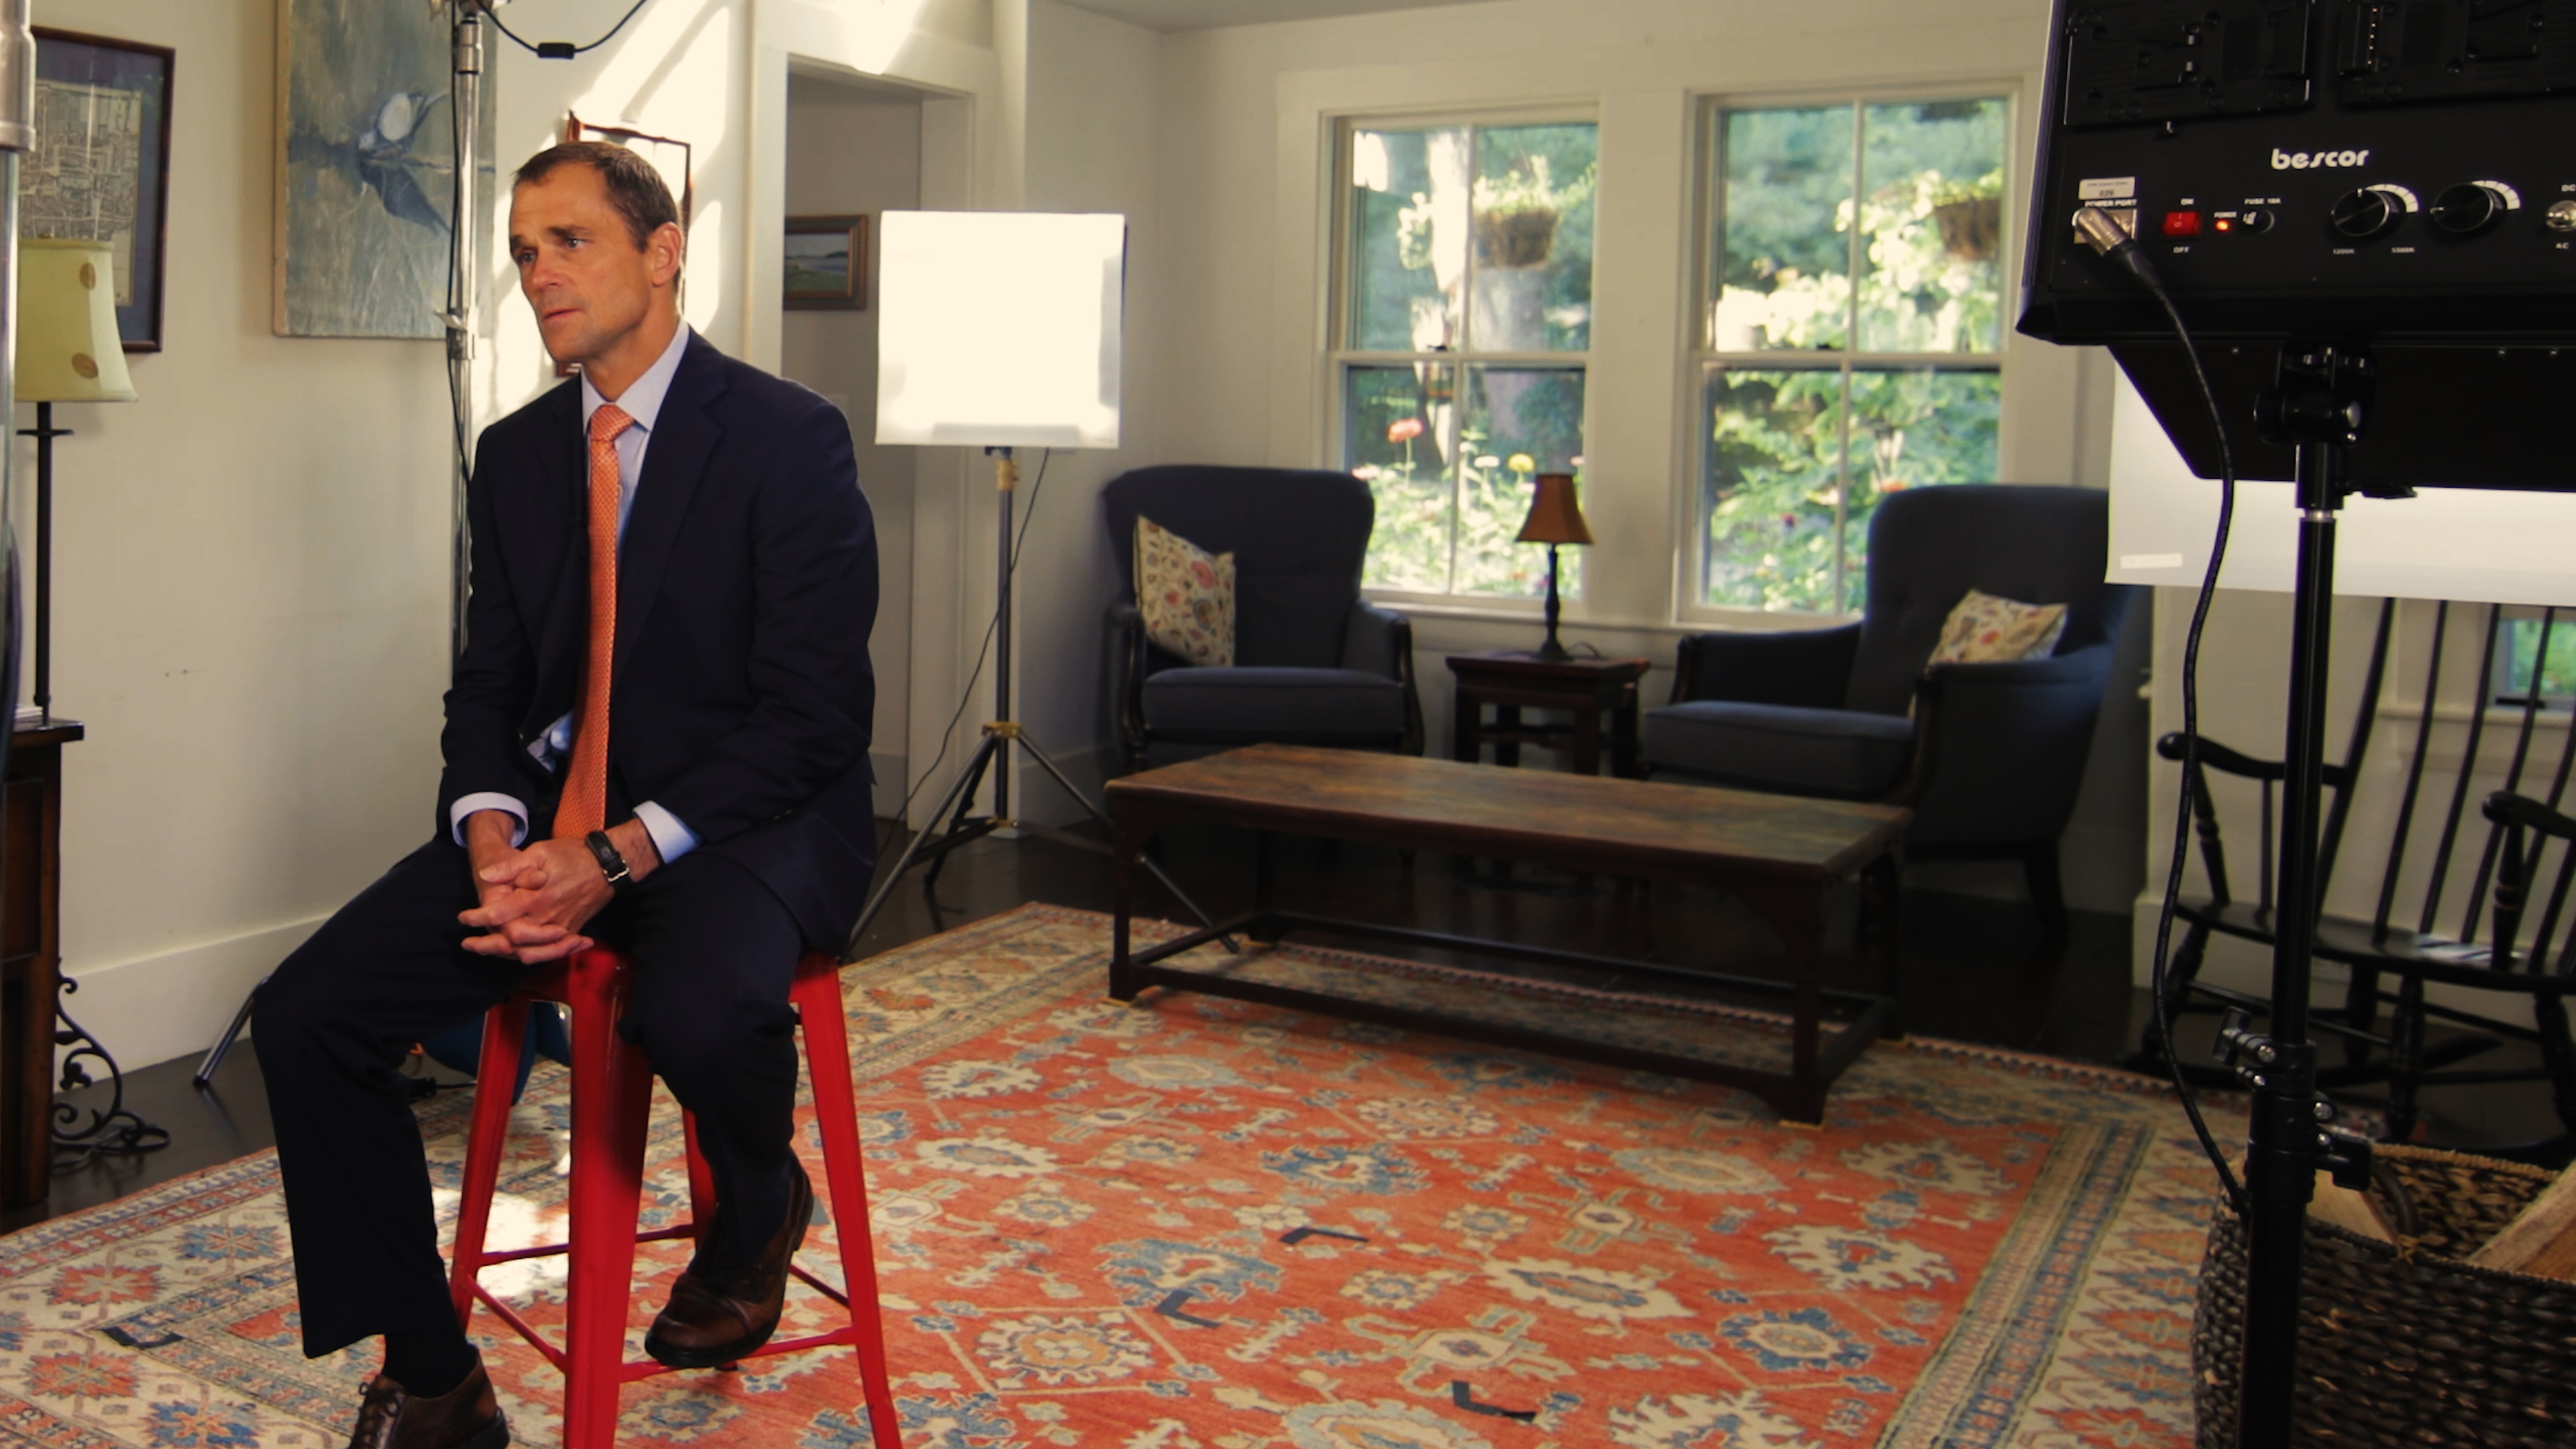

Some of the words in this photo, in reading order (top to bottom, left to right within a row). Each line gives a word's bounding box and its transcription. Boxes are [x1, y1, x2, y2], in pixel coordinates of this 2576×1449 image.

[2271, 148, 2370, 170] bescor
[2114, 199, 2138, 207] PORT
[2180, 197, 2194, 205] ON
[2244, 197, 2264, 205] FUSE
